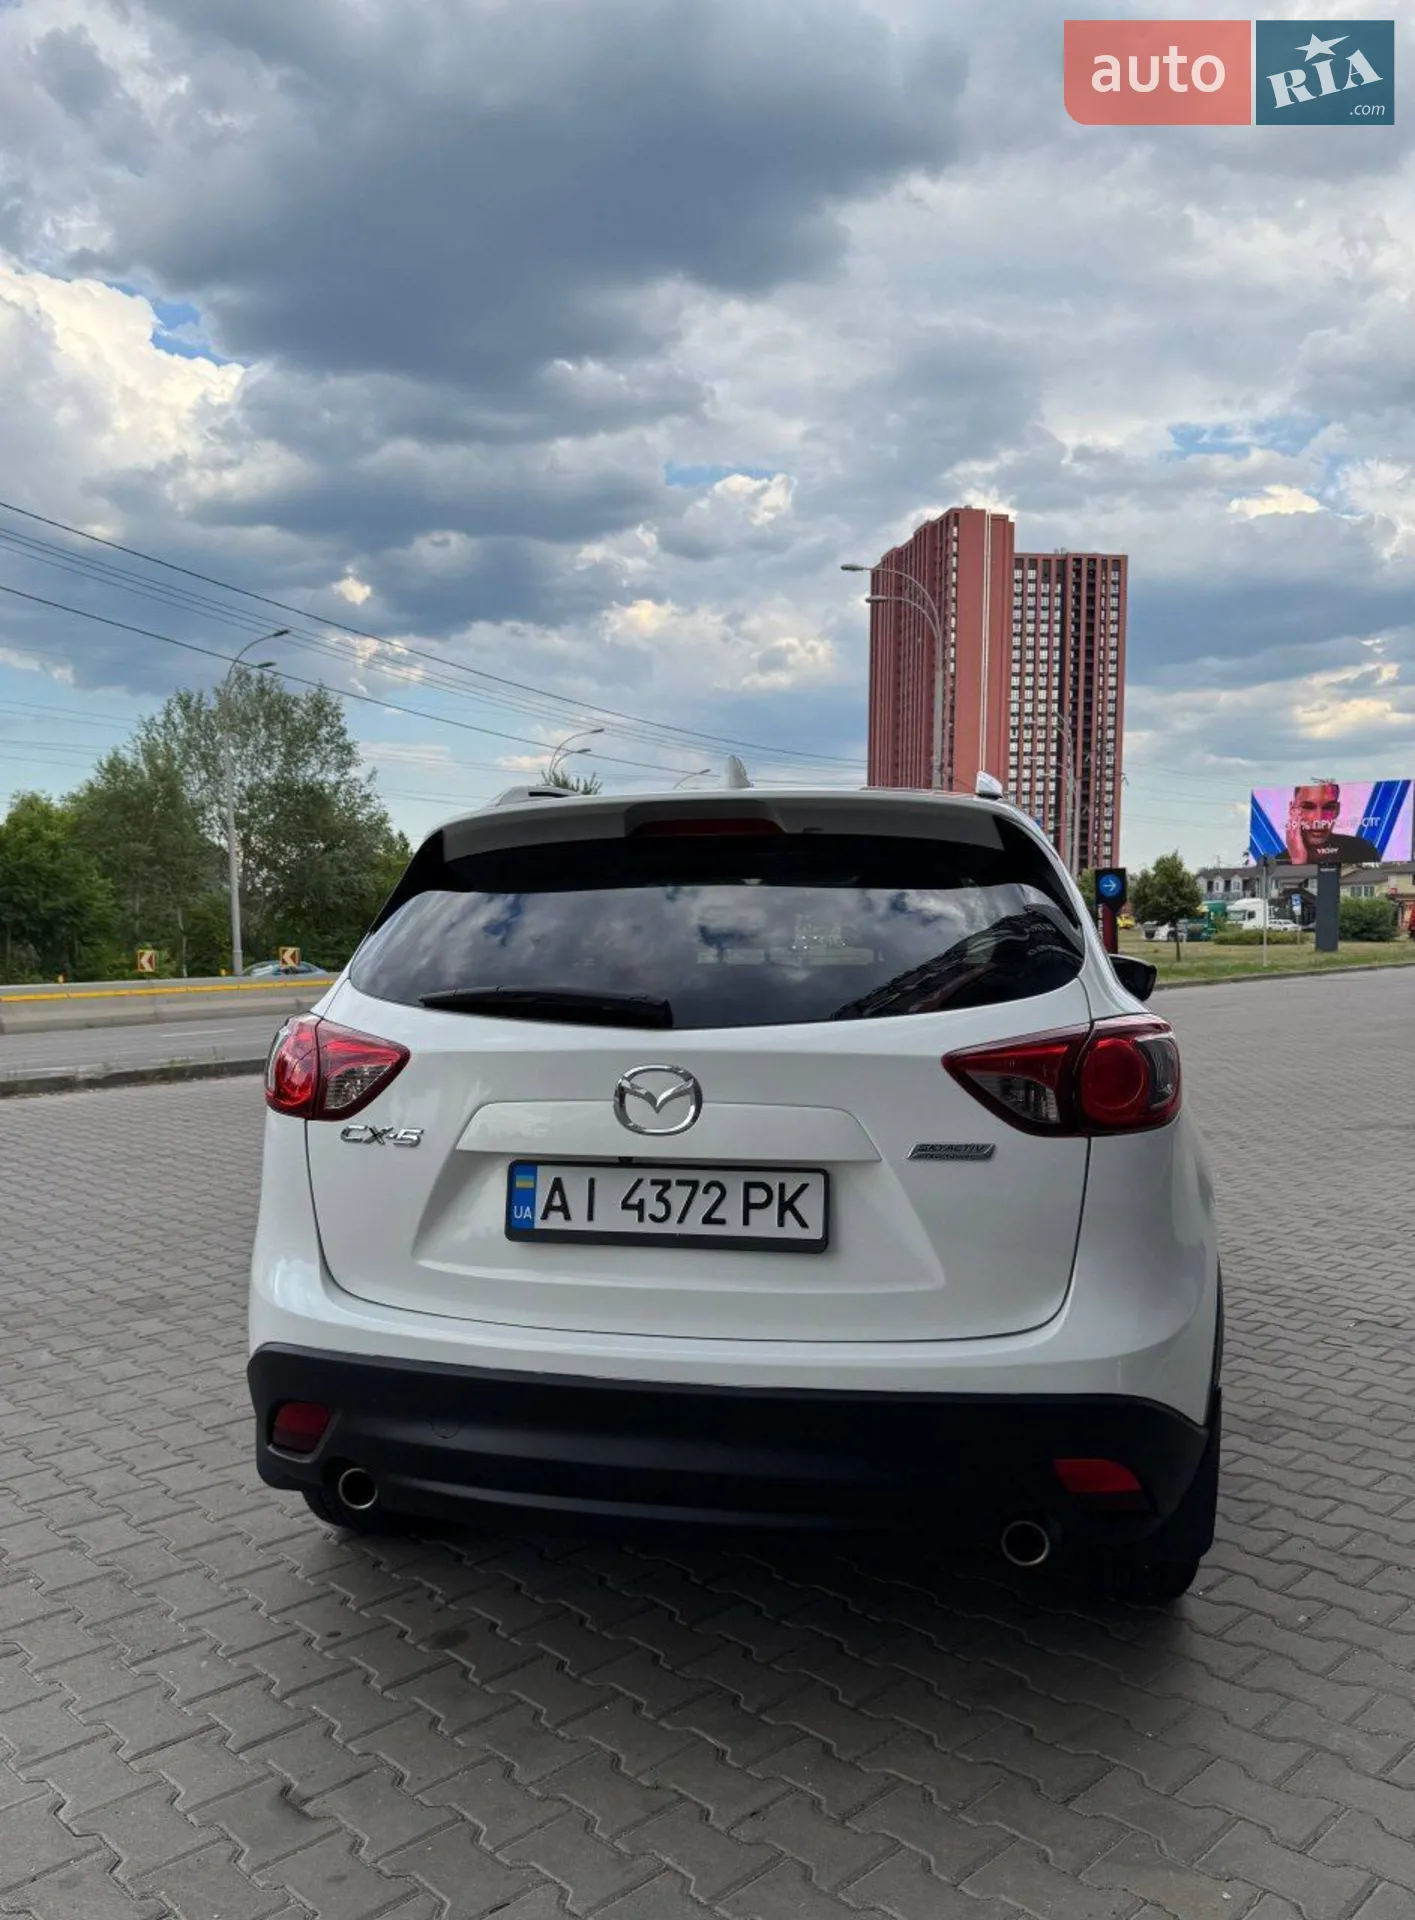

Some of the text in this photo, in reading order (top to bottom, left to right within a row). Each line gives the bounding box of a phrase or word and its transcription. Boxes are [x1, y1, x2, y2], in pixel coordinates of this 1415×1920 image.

[341, 1124, 424, 1148] CX-5
[513, 1204, 532, 1219] UA
[540, 1177, 810, 1229] AI 4372 PK
